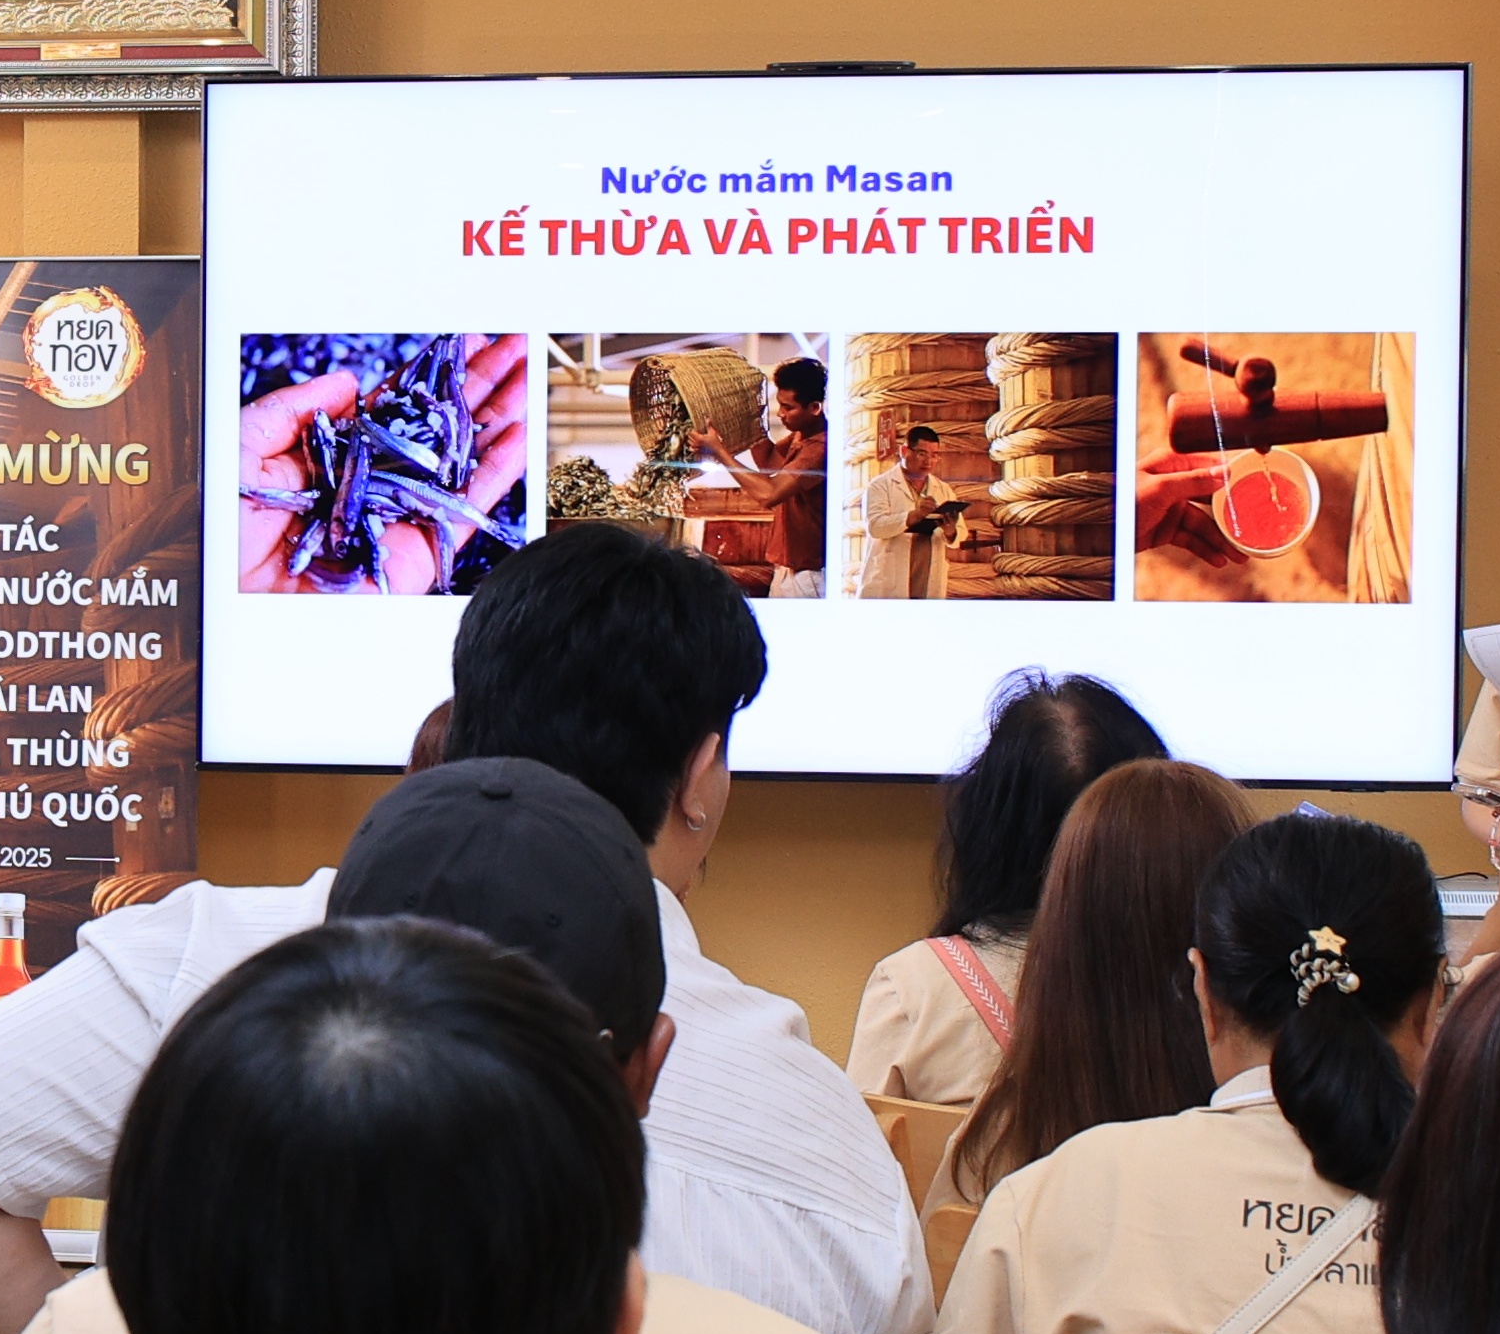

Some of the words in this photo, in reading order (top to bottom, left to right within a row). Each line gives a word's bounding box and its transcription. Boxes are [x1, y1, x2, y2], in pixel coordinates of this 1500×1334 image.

[600, 160, 708, 197] Nước
[716, 158, 814, 195] mắm
[826, 163, 953, 193] Masan
[461, 205, 527, 258] KẾ
[541, 209, 692, 256] THỪA
[704, 205, 773, 256] VÀ
[786, 204, 926, 256] PHÁT
[938, 198, 1096, 255] TRIỂN
[57, 319, 113, 340] หยด
[49, 344, 118, 372] ทอง
[63, 374, 102, 382] GOLDEN
[101, 566, 178, 607] MẮM
[28, 686, 92, 713] LAN
[7, 731, 130, 768] THÙNG
[42, 785, 143, 827] QUỐC
